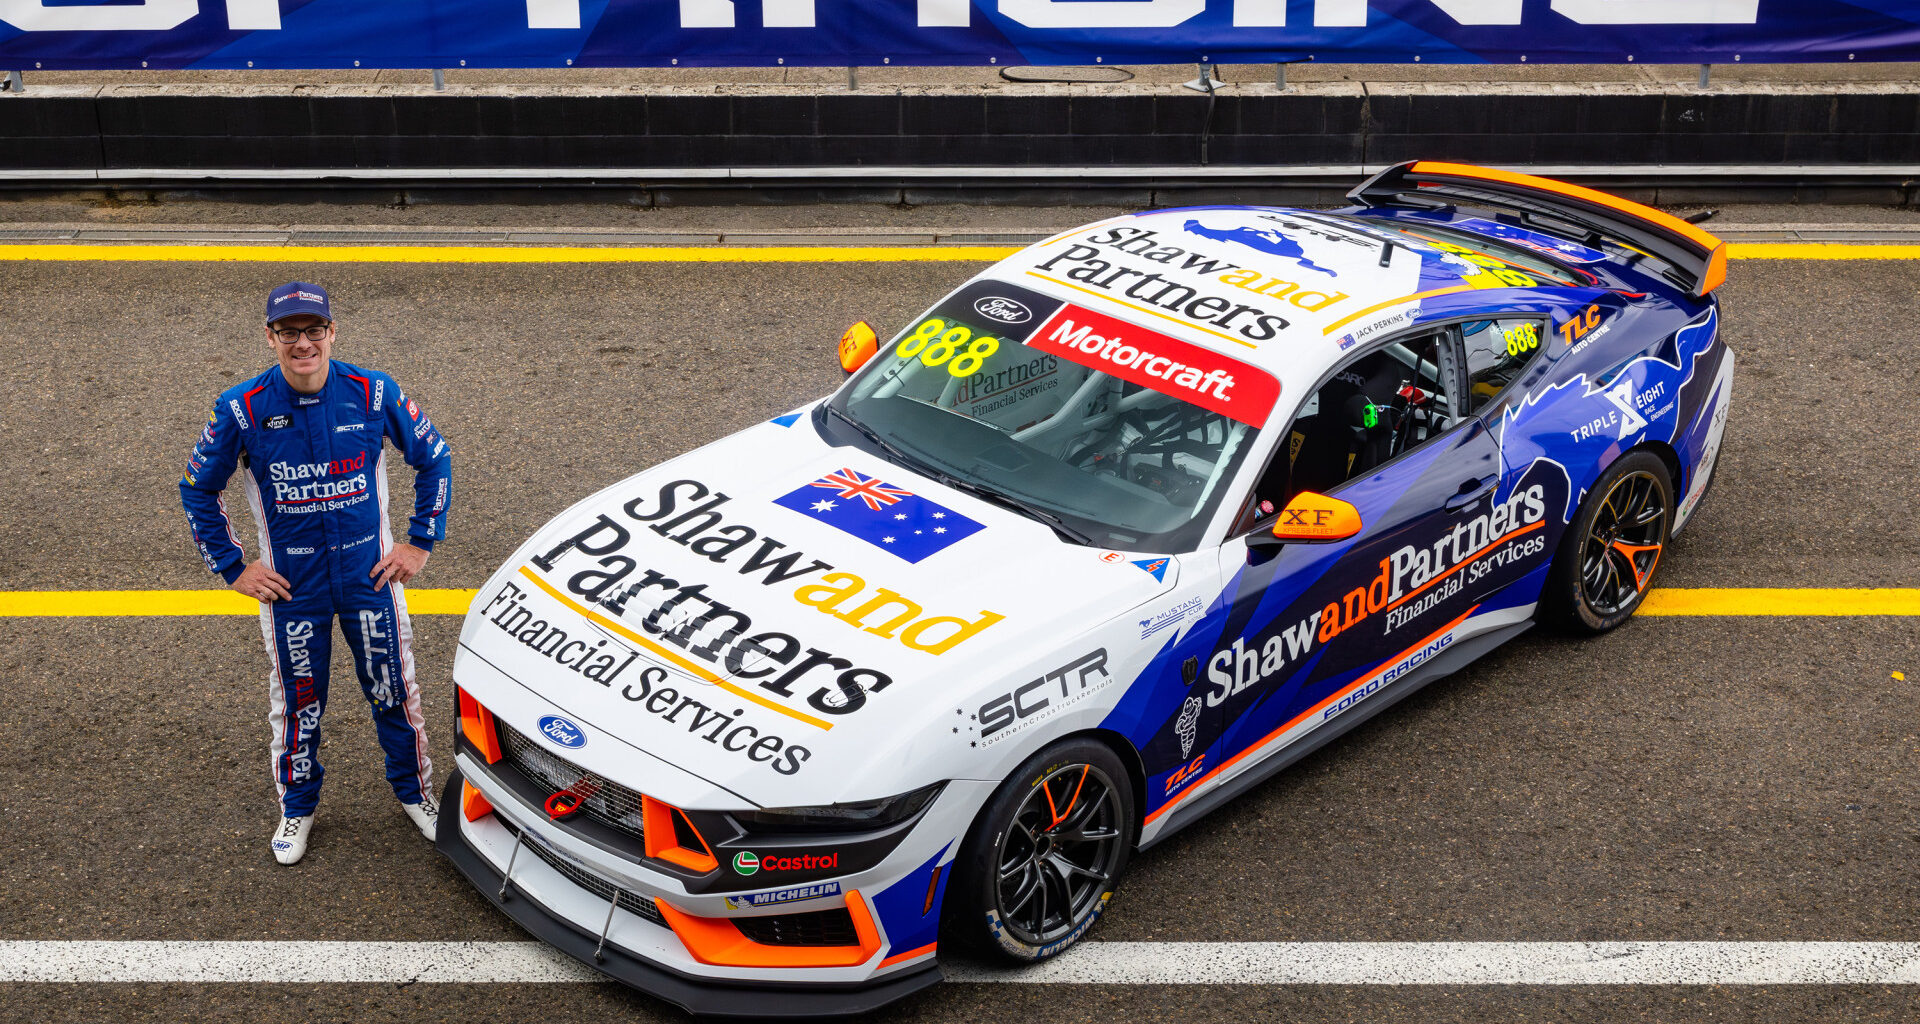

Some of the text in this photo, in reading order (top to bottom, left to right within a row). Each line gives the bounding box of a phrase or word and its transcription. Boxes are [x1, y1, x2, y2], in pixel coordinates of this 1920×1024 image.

[1087, 227, 1350, 312] Shawand
[1034, 244, 1291, 341] Partners
[981, 299, 1023, 321] Ford
[1560, 304, 1601, 346] TLC
[1356, 315, 1404, 339] JACK PERKINS
[1503, 322, 1538, 356] 888
[1571, 324, 1610, 355] AUTO CENTRE
[896, 319, 999, 378] 888
[373, 379, 384, 411] sparco
[972, 378, 1058, 417] Financial Services
[1636, 381, 1665, 409] EIGHT
[1644, 404, 1656, 415] RACE
[230, 399, 249, 430] sparco
[335, 423, 364, 432] SCTR
[1571, 411, 1618, 443] TRIPLE
[269, 450, 366, 481] Shawand
[273, 473, 367, 502] Partners
[276, 493, 370, 514] Financial Services
[342, 542, 356, 550] Jack
[1104, 553, 1119, 561] E
[623, 479, 1007, 656] Shawand
[1206, 484, 1546, 707] ShawandPartners
[1383, 535, 1545, 636] Financial Services
[530, 513, 894, 715] Partners
[1157, 596, 1202, 620] MUSTANG
[1188, 605, 1203, 616] CUP
[359, 609, 394, 707] SCTR
[480, 581, 812, 776] Financial Services
[978, 647, 1109, 738] SCTR
[1323, 633, 1453, 720] FORD RACING
[543, 719, 578, 744] Ford
[1165, 754, 1206, 791] TLC
[762, 852, 838, 871] Castrol
[754, 883, 838, 904] MICHELIN
[1041, 914, 1095, 957] MICHELIN
